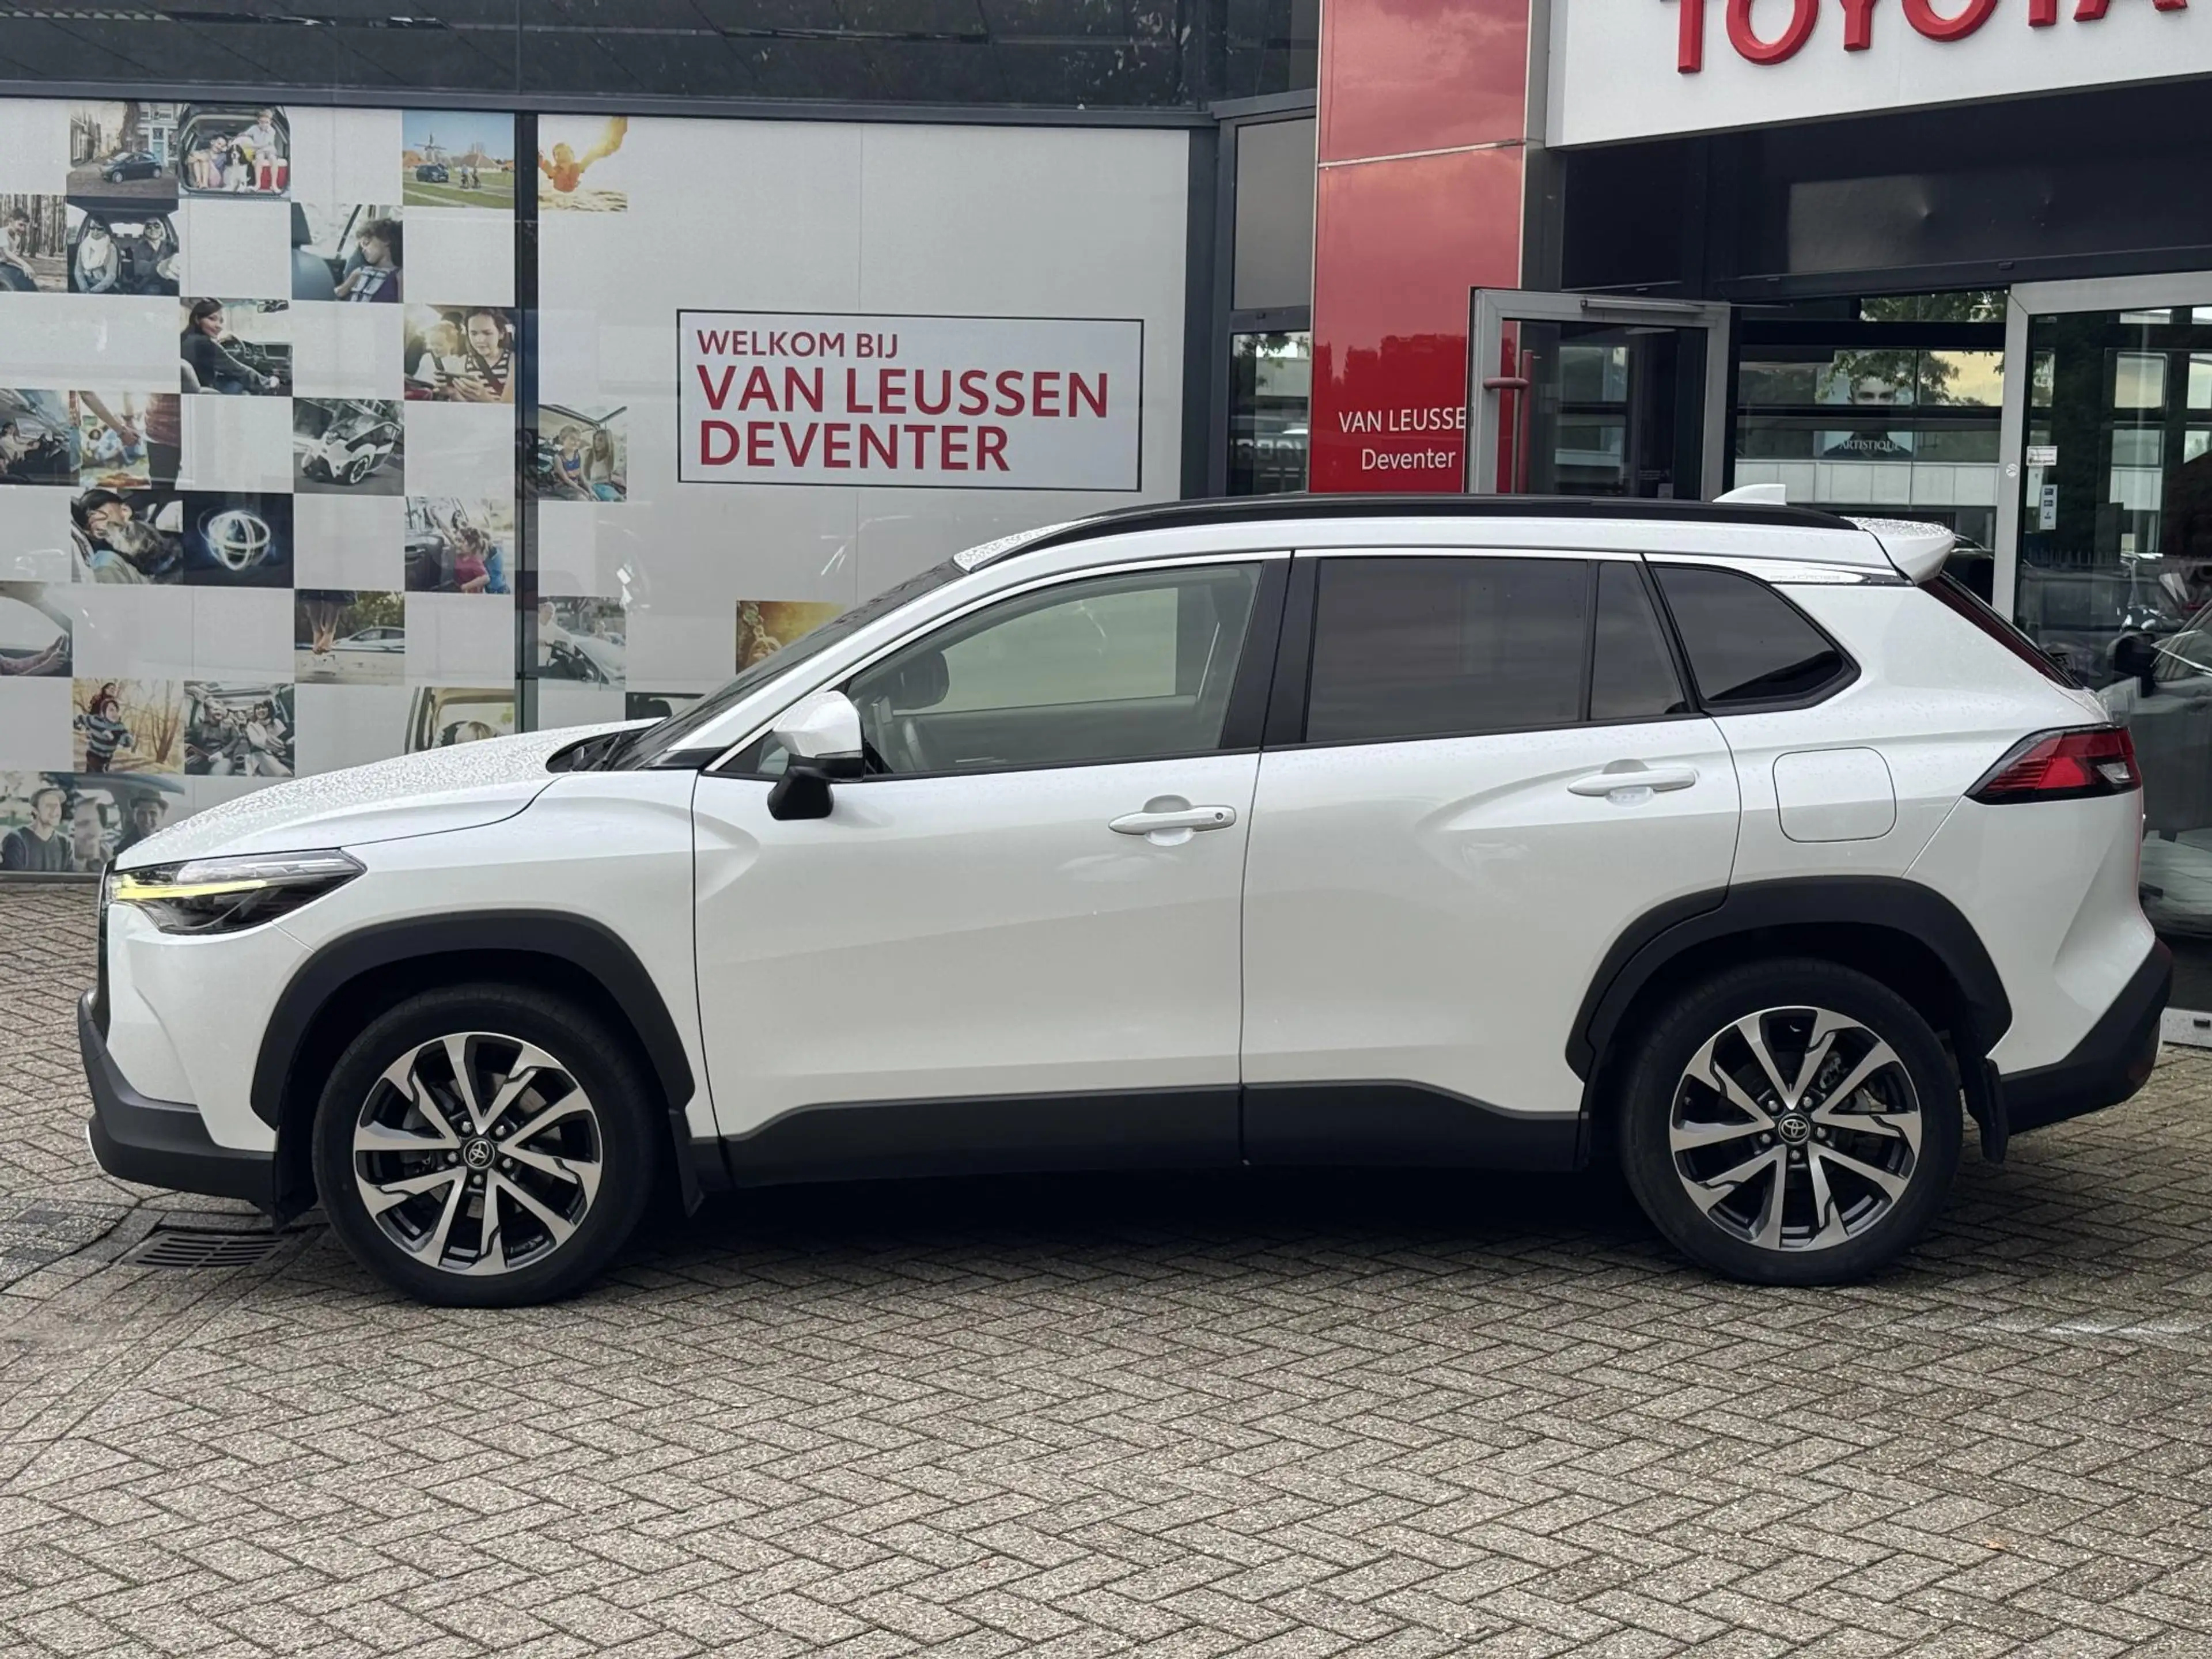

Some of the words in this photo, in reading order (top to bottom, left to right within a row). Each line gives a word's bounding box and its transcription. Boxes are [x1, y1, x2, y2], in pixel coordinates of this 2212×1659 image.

[1660, 0, 2188, 73] TOYO
[697, 329, 845, 358] WELKOM
[857, 333, 898, 359] BIJ
[696, 365, 823, 413] VAN
[846, 368, 1108, 418] LEUSSEN
[1338, 410, 1382, 433] VAN
[1388, 407, 1465, 431] LEUSSE
[700, 420, 1011, 472] DEVENTER
[1361, 448, 1456, 470] Deventer
